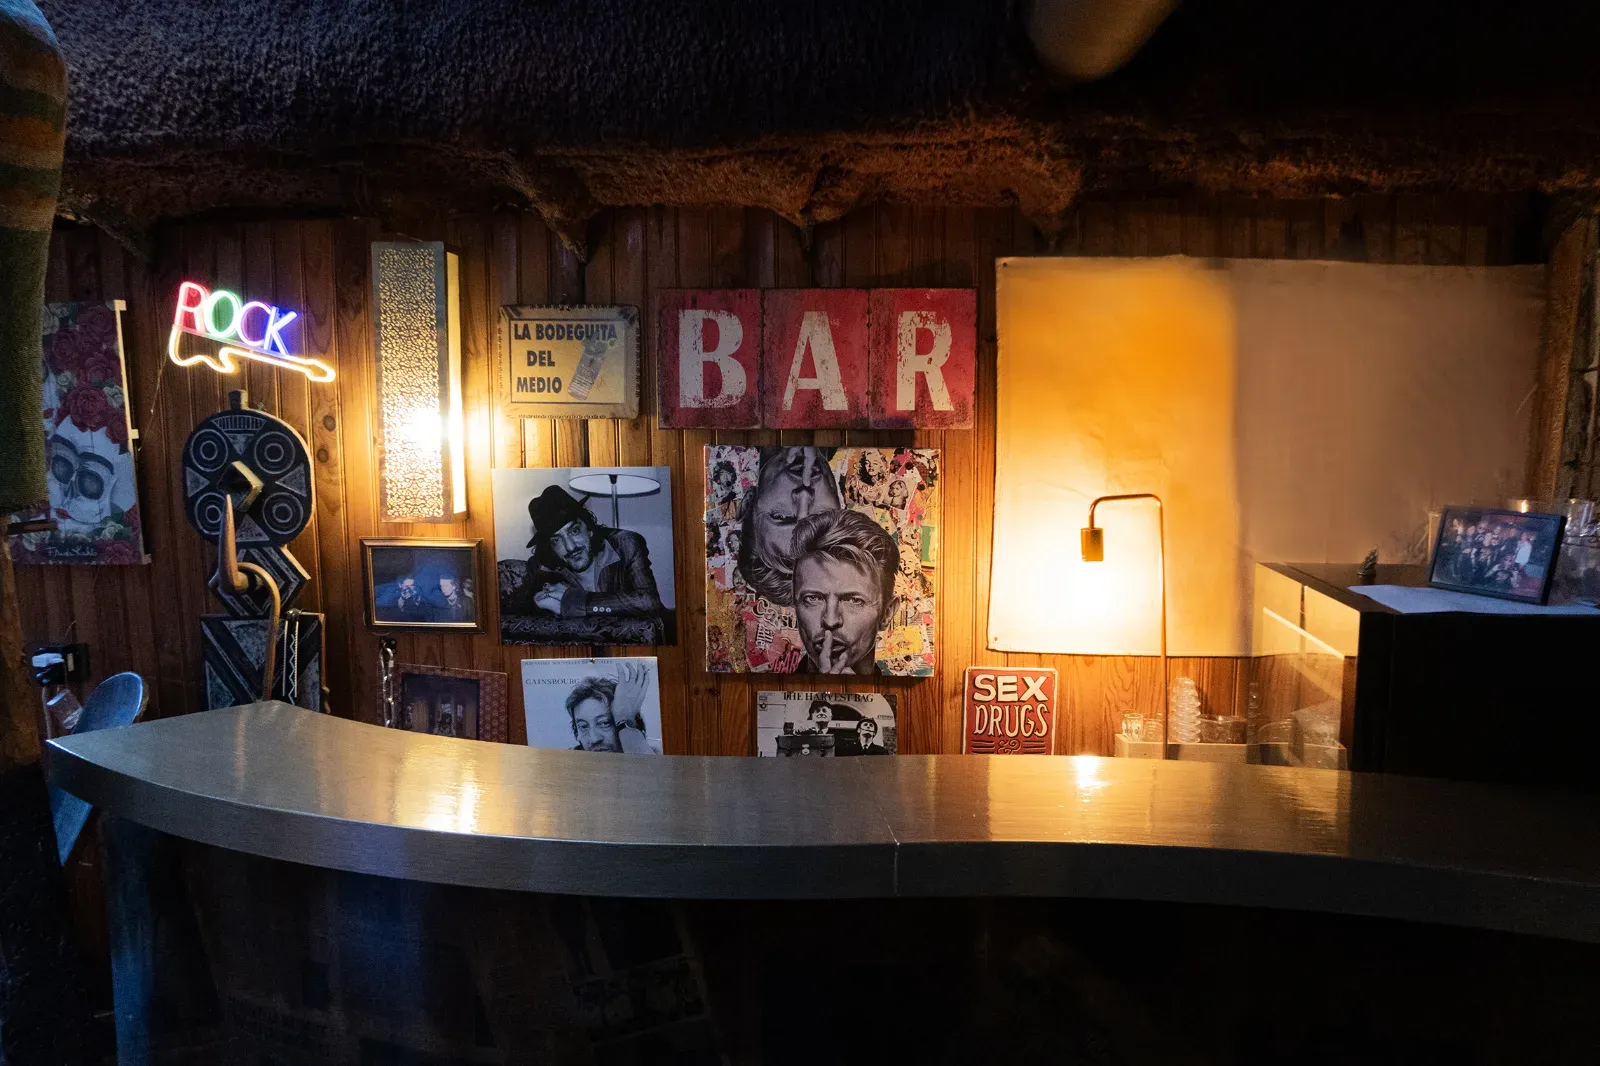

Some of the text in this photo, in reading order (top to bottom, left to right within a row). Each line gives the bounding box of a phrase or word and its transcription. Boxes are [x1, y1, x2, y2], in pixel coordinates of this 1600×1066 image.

[174, 281, 297, 356] ROCK
[514, 323, 617, 341] LA BODEGUITA
[526, 350, 555, 367] DEL
[679, 309, 954, 411] BAR
[516, 376, 562, 394] MEDIO
[805, 692, 852, 702] HARVEST
[855, 692, 874, 703] BAG
[972, 673, 1049, 702] SEX
[973, 703, 1050, 737] DRUGS
